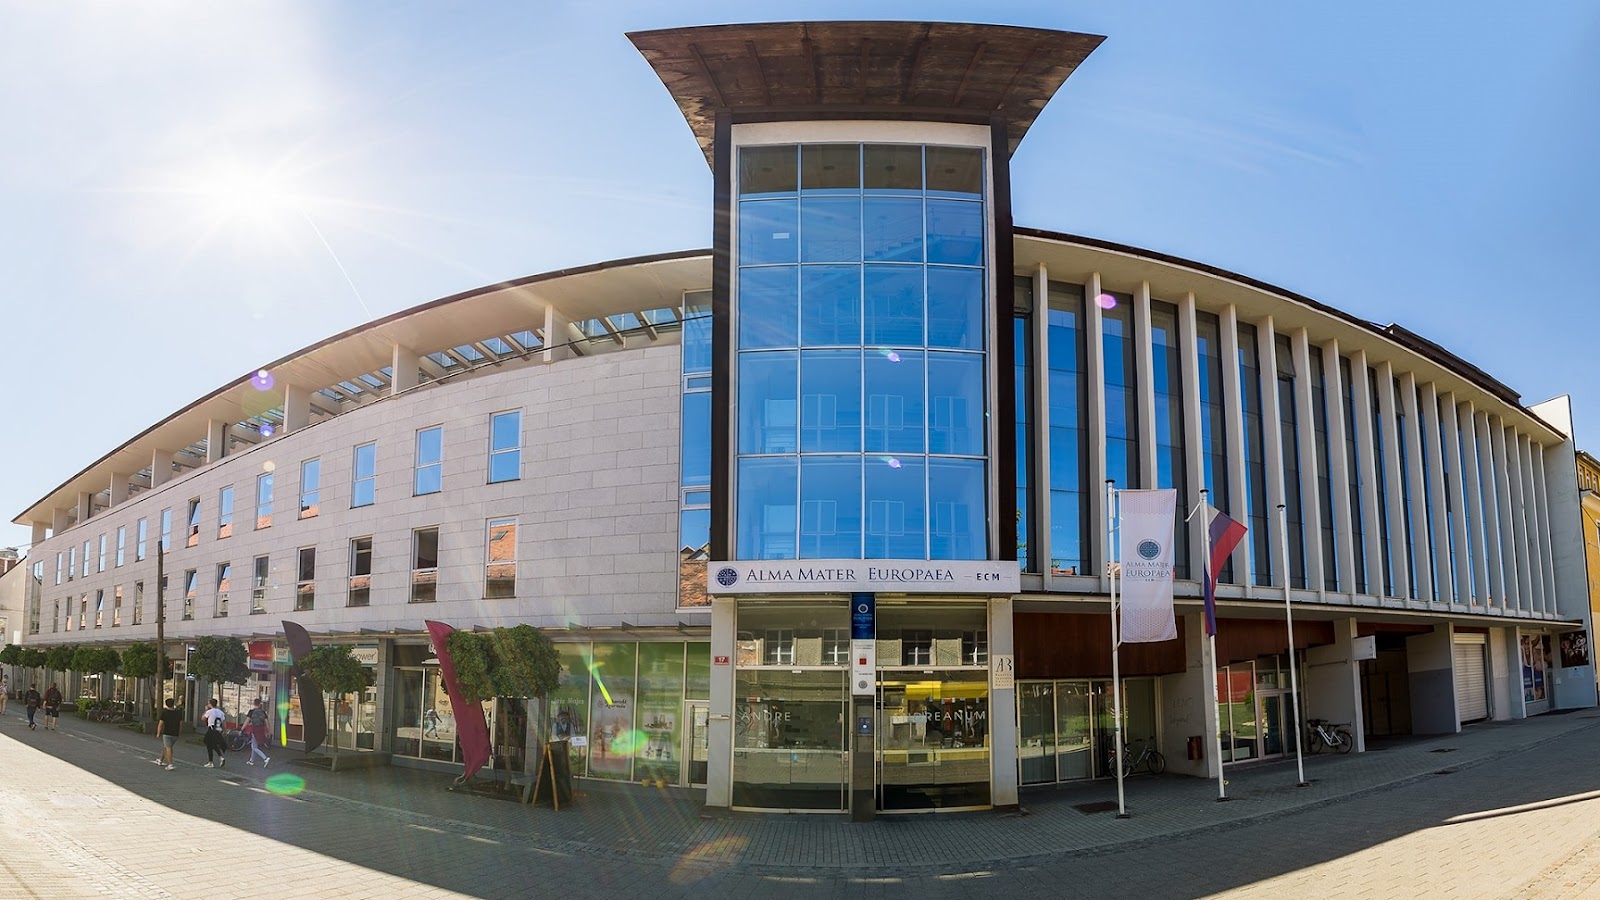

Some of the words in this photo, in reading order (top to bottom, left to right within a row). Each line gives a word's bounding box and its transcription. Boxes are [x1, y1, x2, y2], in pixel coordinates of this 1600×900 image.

[746, 568, 793, 582] ALMA
[797, 568, 857, 582] MATER
[868, 567, 954, 583] EUROPAEA
[976, 572, 1001, 582] ECM
[741, 711, 791, 722] ANDRE
